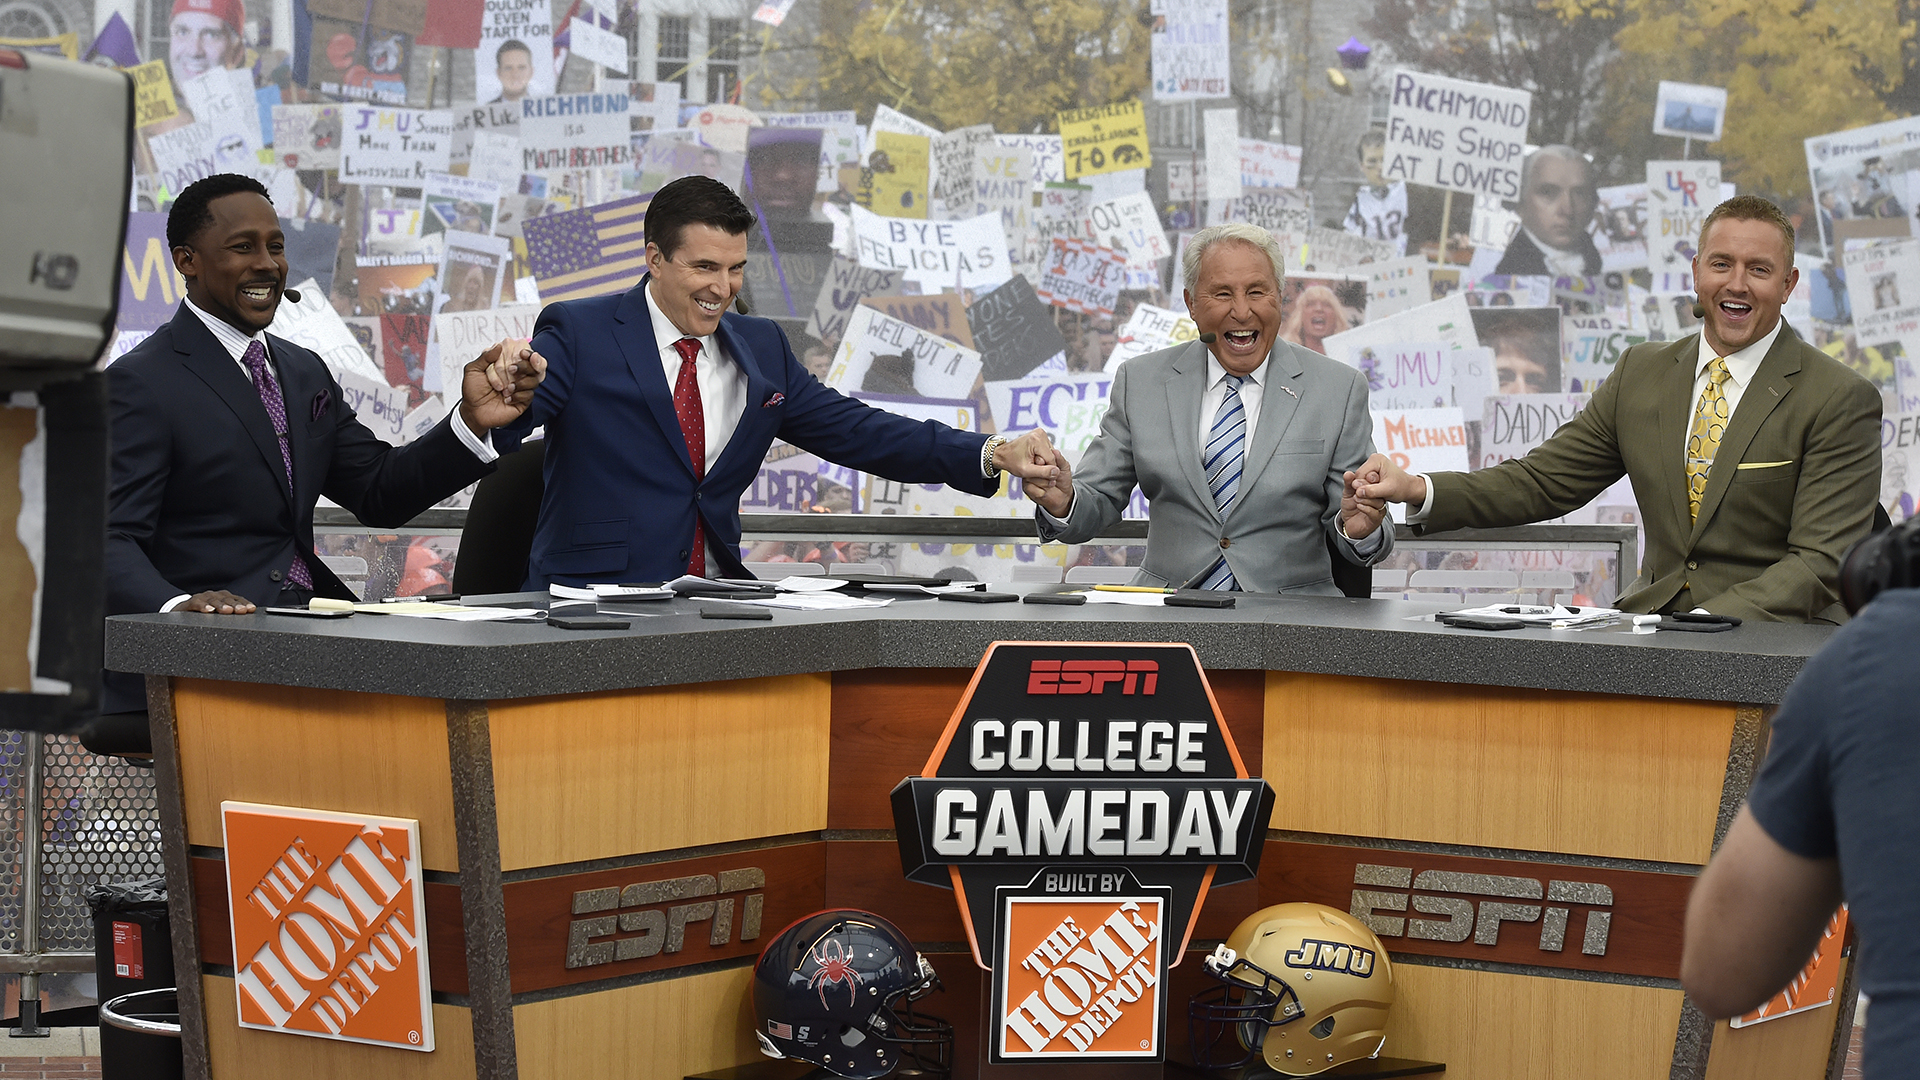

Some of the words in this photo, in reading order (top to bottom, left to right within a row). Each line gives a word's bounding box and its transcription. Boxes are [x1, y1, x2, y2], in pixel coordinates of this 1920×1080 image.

[485, 0, 544, 11] OULDN'T
[494, 12, 530, 25] EVEN
[523, 25, 550, 37] FOR
[523, 94, 630, 118] RICHMOND
[1393, 74, 1527, 128] RICHMOND
[355, 110, 410, 132] JMU
[401, 135, 436, 152] THAN
[1389, 117, 1445, 150] FANS
[1456, 127, 1521, 163] SHOP
[1068, 148, 1105, 173] 7-0
[1388, 154, 1422, 179] AT
[1435, 158, 1518, 198] LOWES
[976, 180, 1026, 199] WANT
[889, 221, 956, 246] BYE
[976, 203, 1027, 228] BMA
[1091, 202, 1121, 231] OJ
[858, 247, 995, 274] FELICIAS
[1142, 308, 1173, 332] THE
[913, 332, 946, 366] PUT
[1388, 351, 1441, 389] JMU
[337, 372, 405, 435] sy-bitsy
[1026, 660, 1159, 695] ESPN
[970, 720, 1208, 772] COLLEGE
[932, 789, 1252, 856] GAMEDAY
[246, 836, 322, 922] THE
[1045, 874, 1097, 893] BUILT
[1101, 874, 1126, 893] BY
[238, 826, 412, 1027] HOME
[566, 867, 766, 969] ESPN
[1349, 863, 1613, 957] ESPN
[1021, 915, 1087, 979] THE
[1286, 940, 1374, 977] JMU
[310, 907, 417, 1034] DEPOT
[1006, 902, 1158, 1052] HOME
[1062, 956, 1156, 1052] DEPOT
